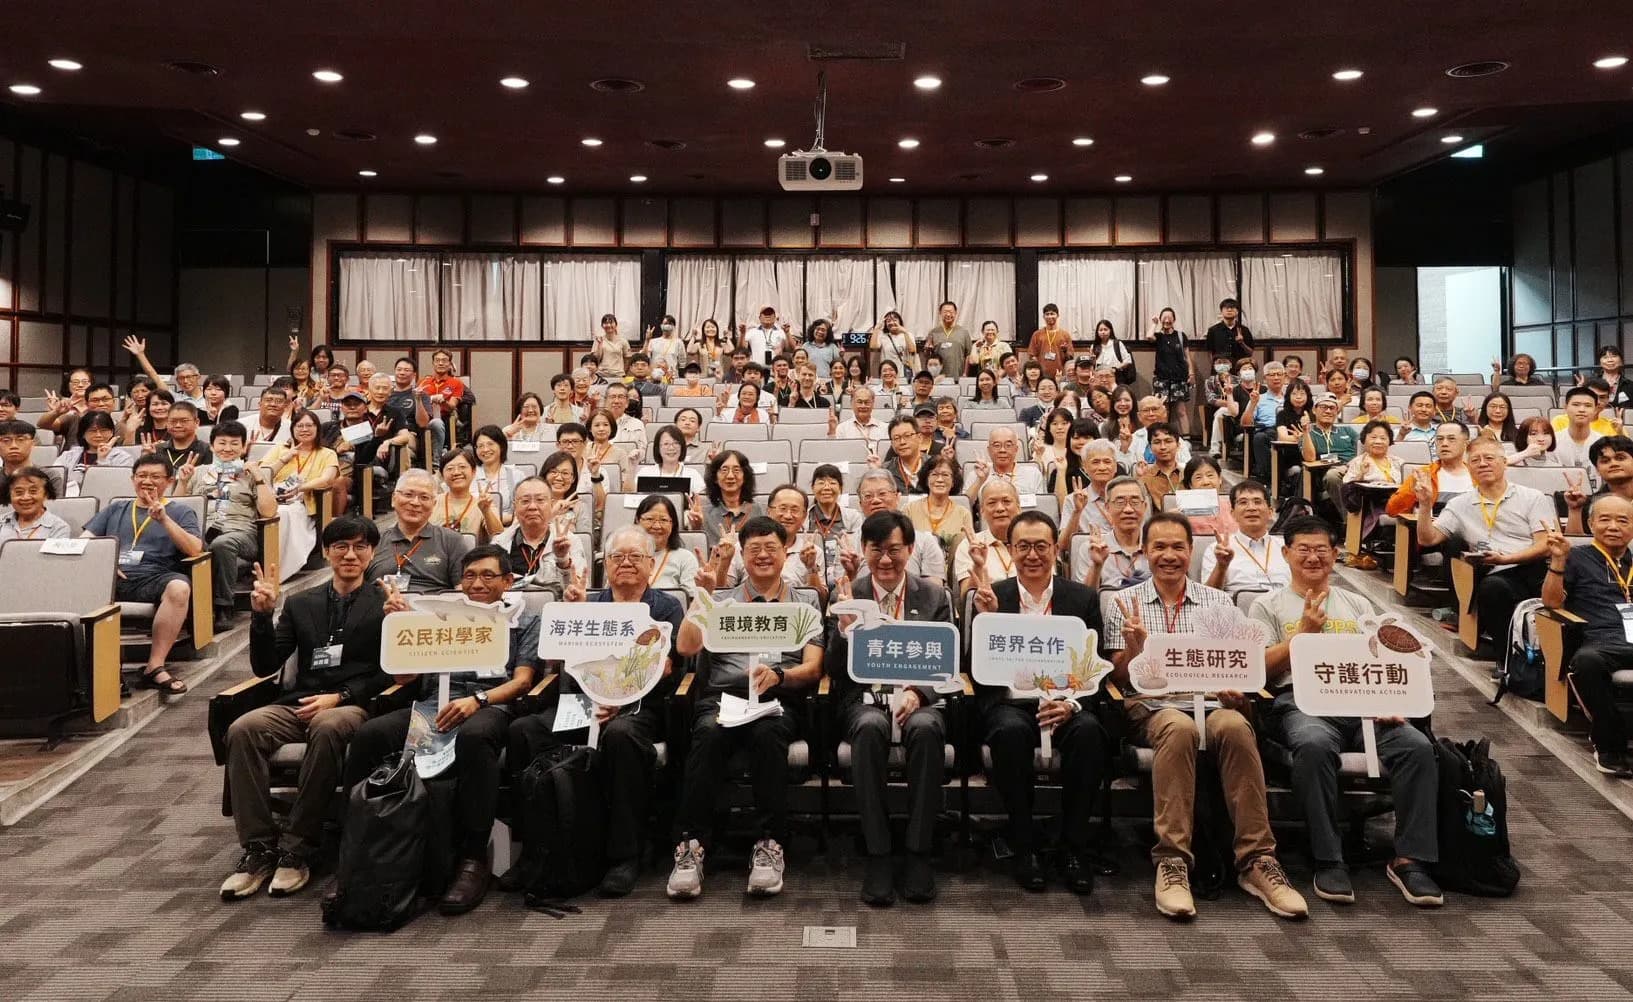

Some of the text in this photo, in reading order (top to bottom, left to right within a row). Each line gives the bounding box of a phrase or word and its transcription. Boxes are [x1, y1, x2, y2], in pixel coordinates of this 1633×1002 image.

[550, 619, 635, 637] 海洋生態系
[719, 615, 789, 632] 環境教育
[396, 626, 493, 646] 公民科學家
[988, 634, 1065, 655] 跨界合作
[866, 638, 943, 660] 青年參與
[1164, 648, 1248, 669] 生態研究
[893, 663, 942, 671] ENGAGEMENT
[1314, 661, 1409, 685] 守護行動
[1379, 688, 1407, 696] ACTION
